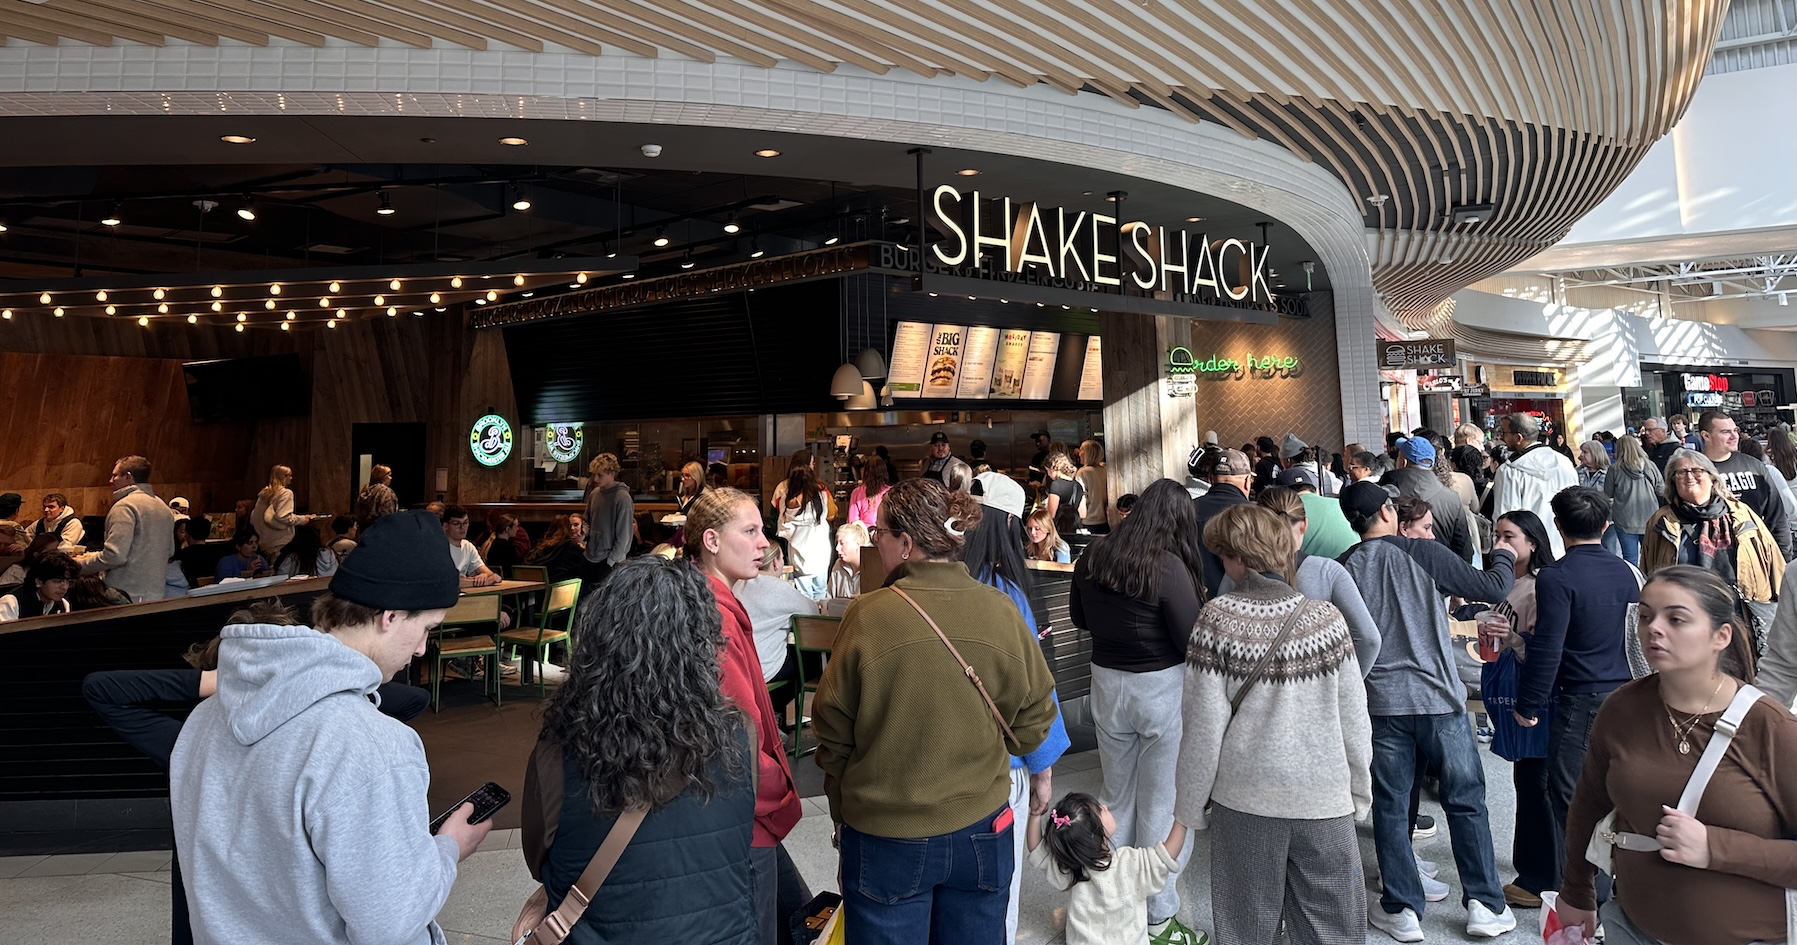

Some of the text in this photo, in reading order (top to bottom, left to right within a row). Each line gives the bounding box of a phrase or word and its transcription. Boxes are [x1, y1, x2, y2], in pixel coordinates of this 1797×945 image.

[932, 185, 1274, 304] SHAKE SHACK
[782, 247, 855, 279] FLOATS
[941, 332, 960, 346] BIG
[933, 346, 959, 356] SHACK
[1406, 343, 1444, 355] SHAKE
[1246, 352, 1298, 369] here
[1407, 354, 1446, 365] SHACK
[1684, 373, 1729, 392] GameStop
[475, 416, 508, 431] BROOKLYN
[1719, 471, 1757, 491] CAGO
